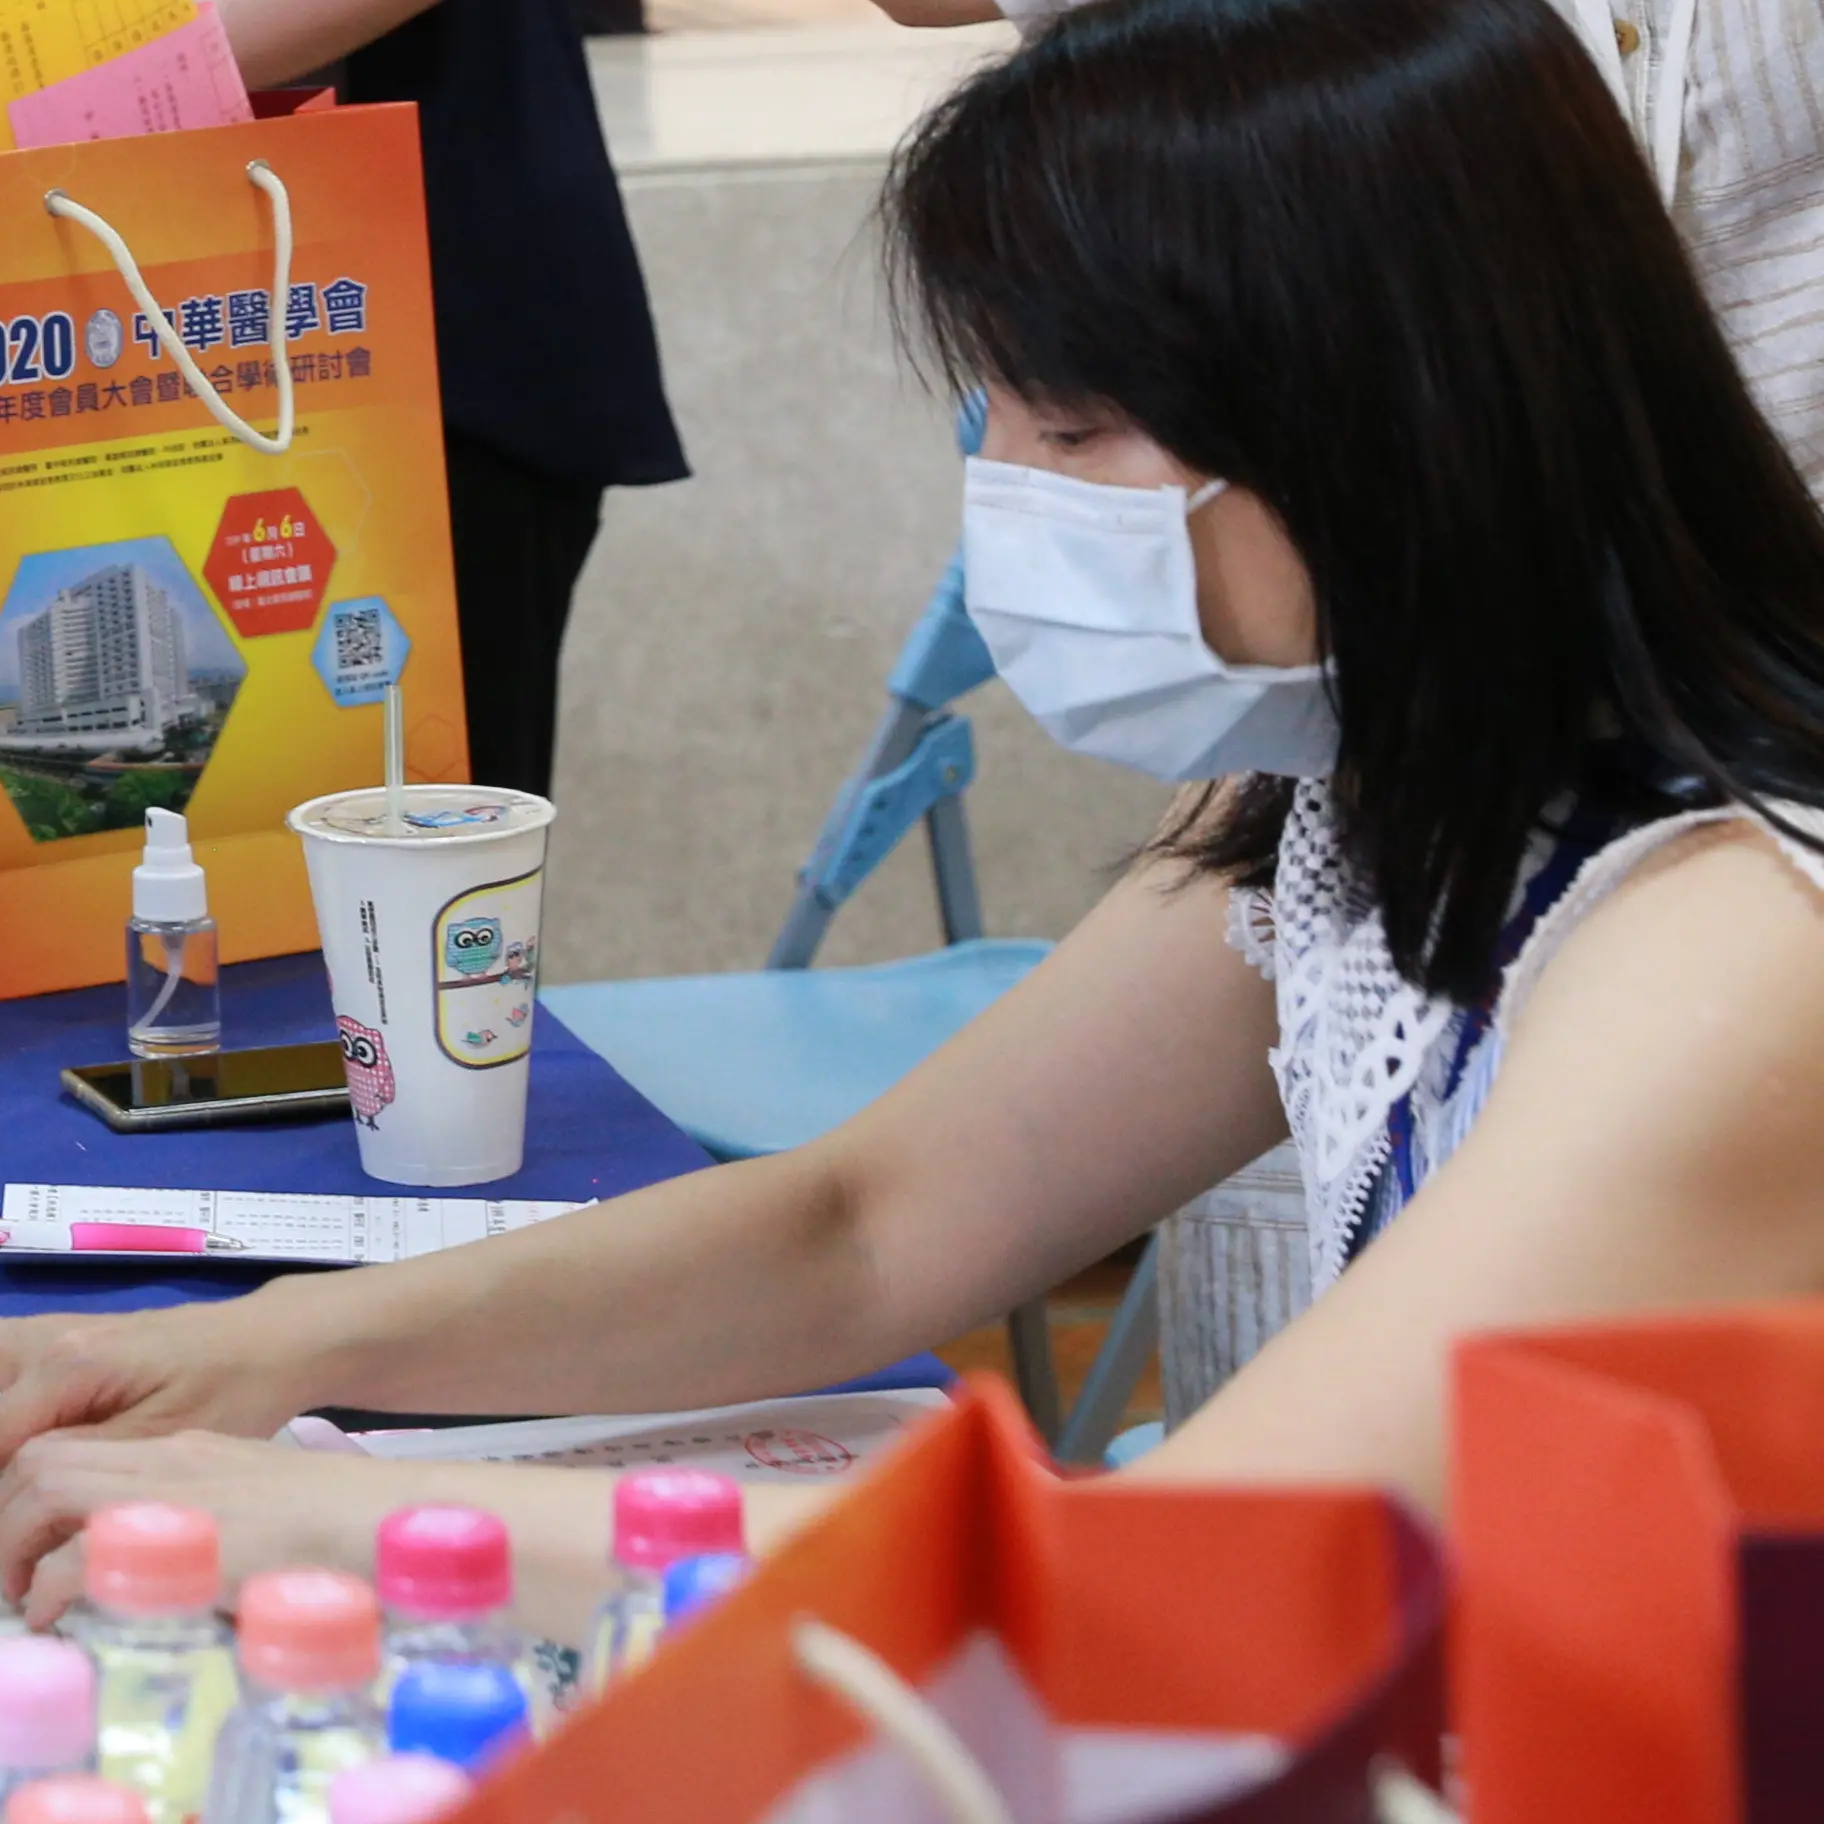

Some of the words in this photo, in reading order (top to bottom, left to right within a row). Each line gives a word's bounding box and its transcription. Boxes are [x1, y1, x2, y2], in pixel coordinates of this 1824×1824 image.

[132, 277, 367, 359] 中華醫學會
